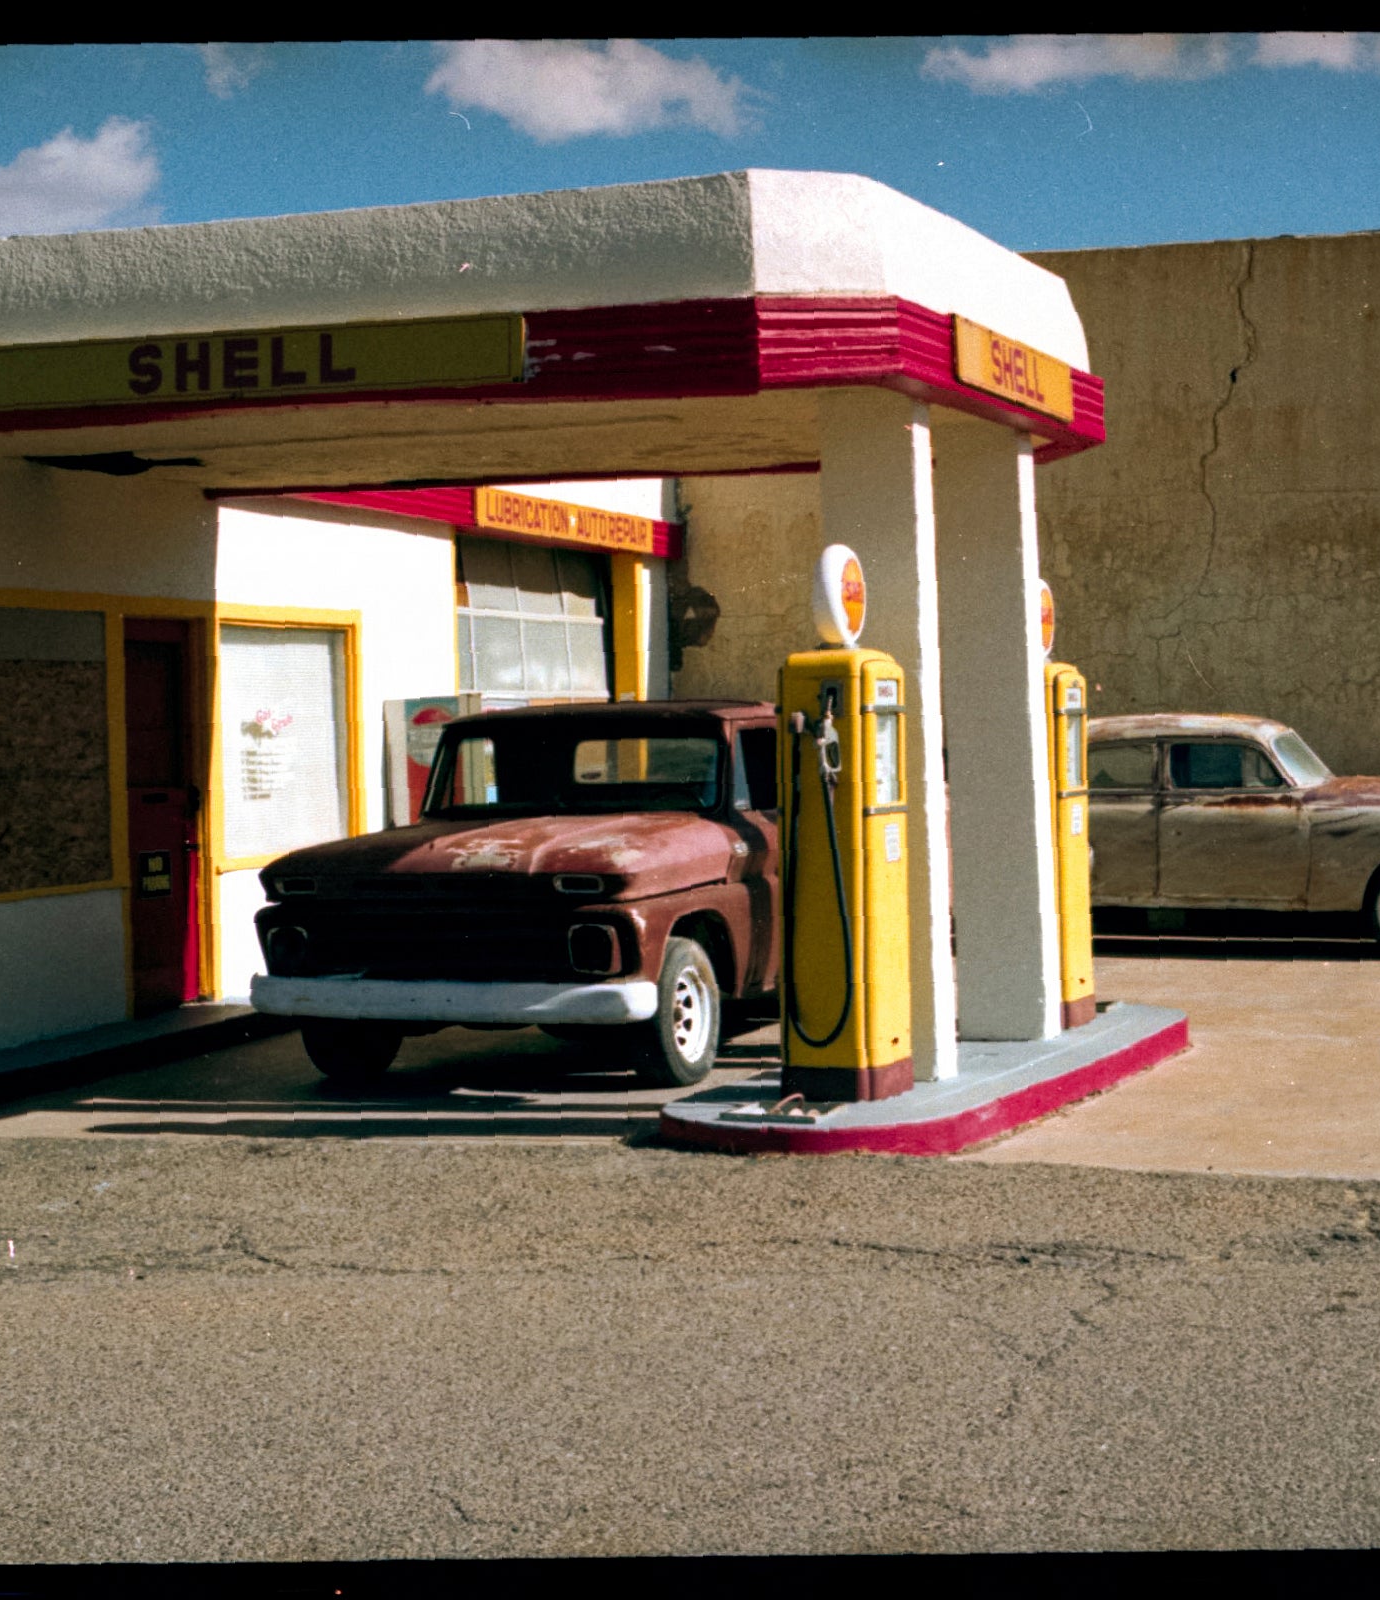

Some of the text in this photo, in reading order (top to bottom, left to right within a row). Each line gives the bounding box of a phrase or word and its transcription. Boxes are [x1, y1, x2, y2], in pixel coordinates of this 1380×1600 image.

[128, 333, 356, 394] SHELL
[991, 340, 1044, 402] SHELL
[486, 492, 569, 534] LUBRICATION
[148, 856, 163, 872] NO
